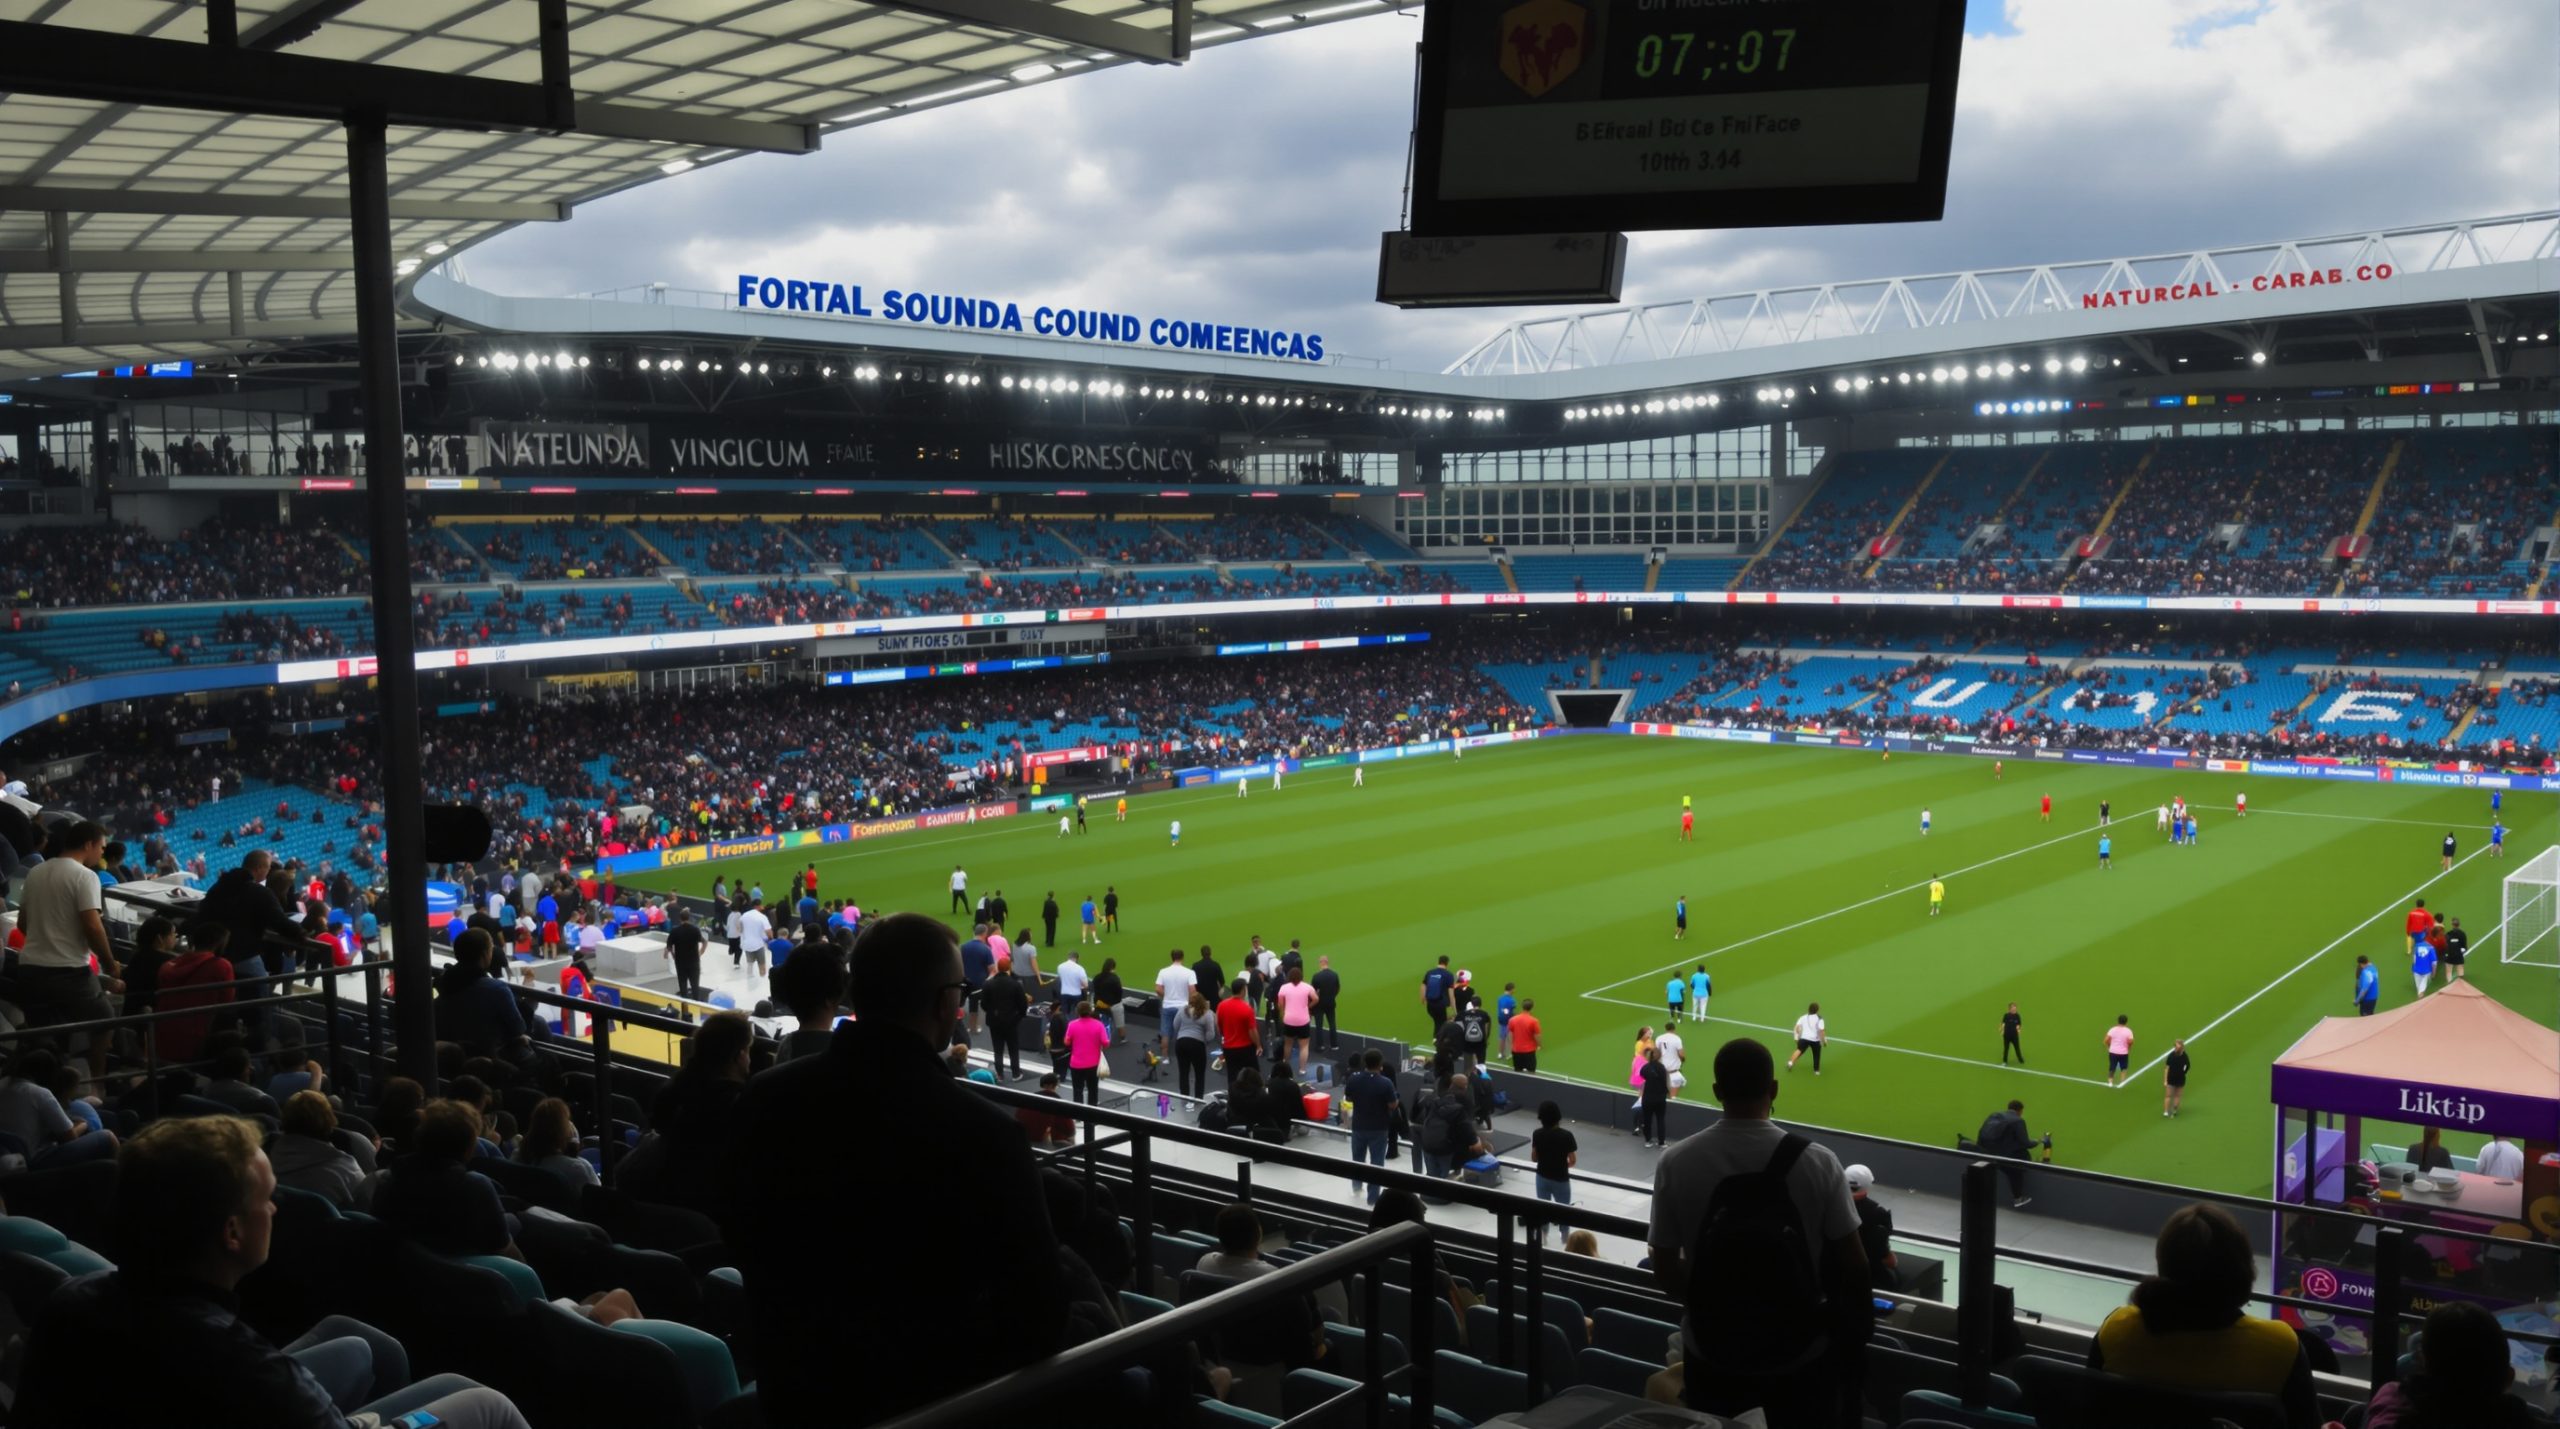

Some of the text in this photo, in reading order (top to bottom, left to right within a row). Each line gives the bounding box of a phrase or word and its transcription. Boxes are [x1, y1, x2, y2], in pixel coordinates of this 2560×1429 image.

[738, 274, 1325, 361] FORTAL SOUNDA COUND COMEENCAS
[2082, 281, 2218, 309] NATURCAL
